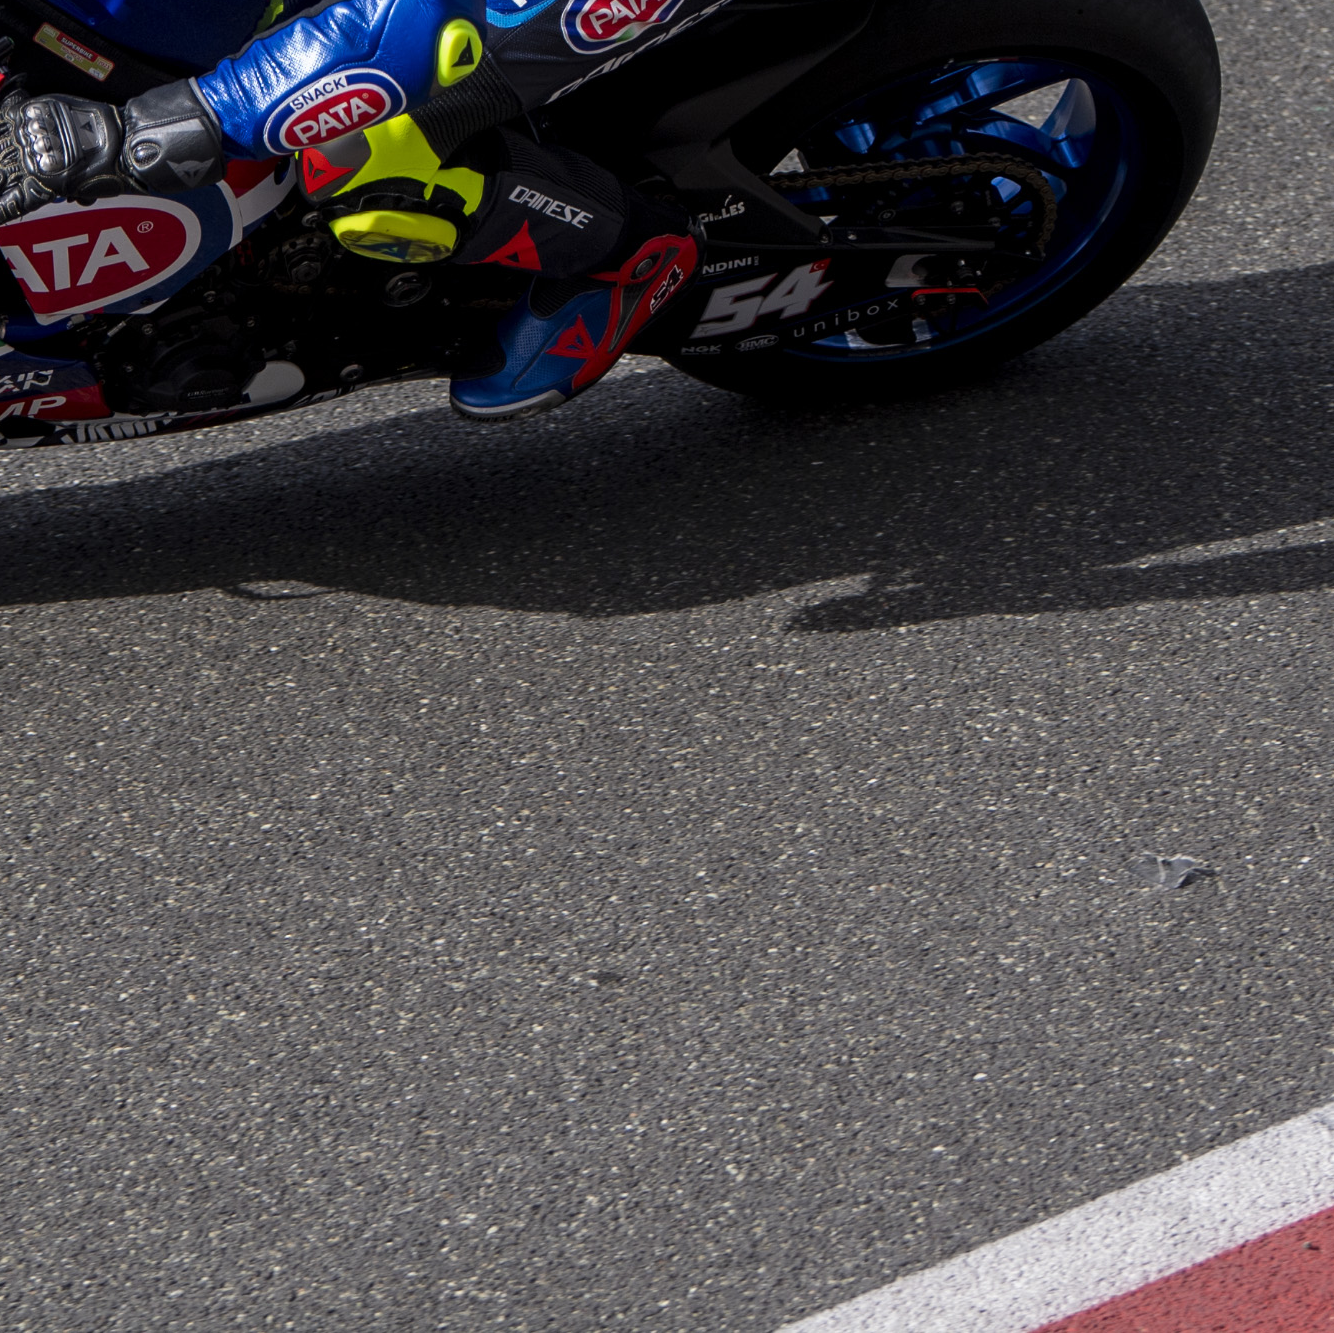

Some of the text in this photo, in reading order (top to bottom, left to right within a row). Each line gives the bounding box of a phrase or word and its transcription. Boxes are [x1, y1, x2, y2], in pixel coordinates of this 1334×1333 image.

[61, 37, 94, 60] SUPERBIKE
[293, 77, 347, 111] SNACK
[293, 97, 377, 144] PATA
[509, 185, 593, 229] DAINESE
[688, 257, 835, 339] 54
[793, 297, 899, 338] unibox
[680, 344, 722, 354] NGK
